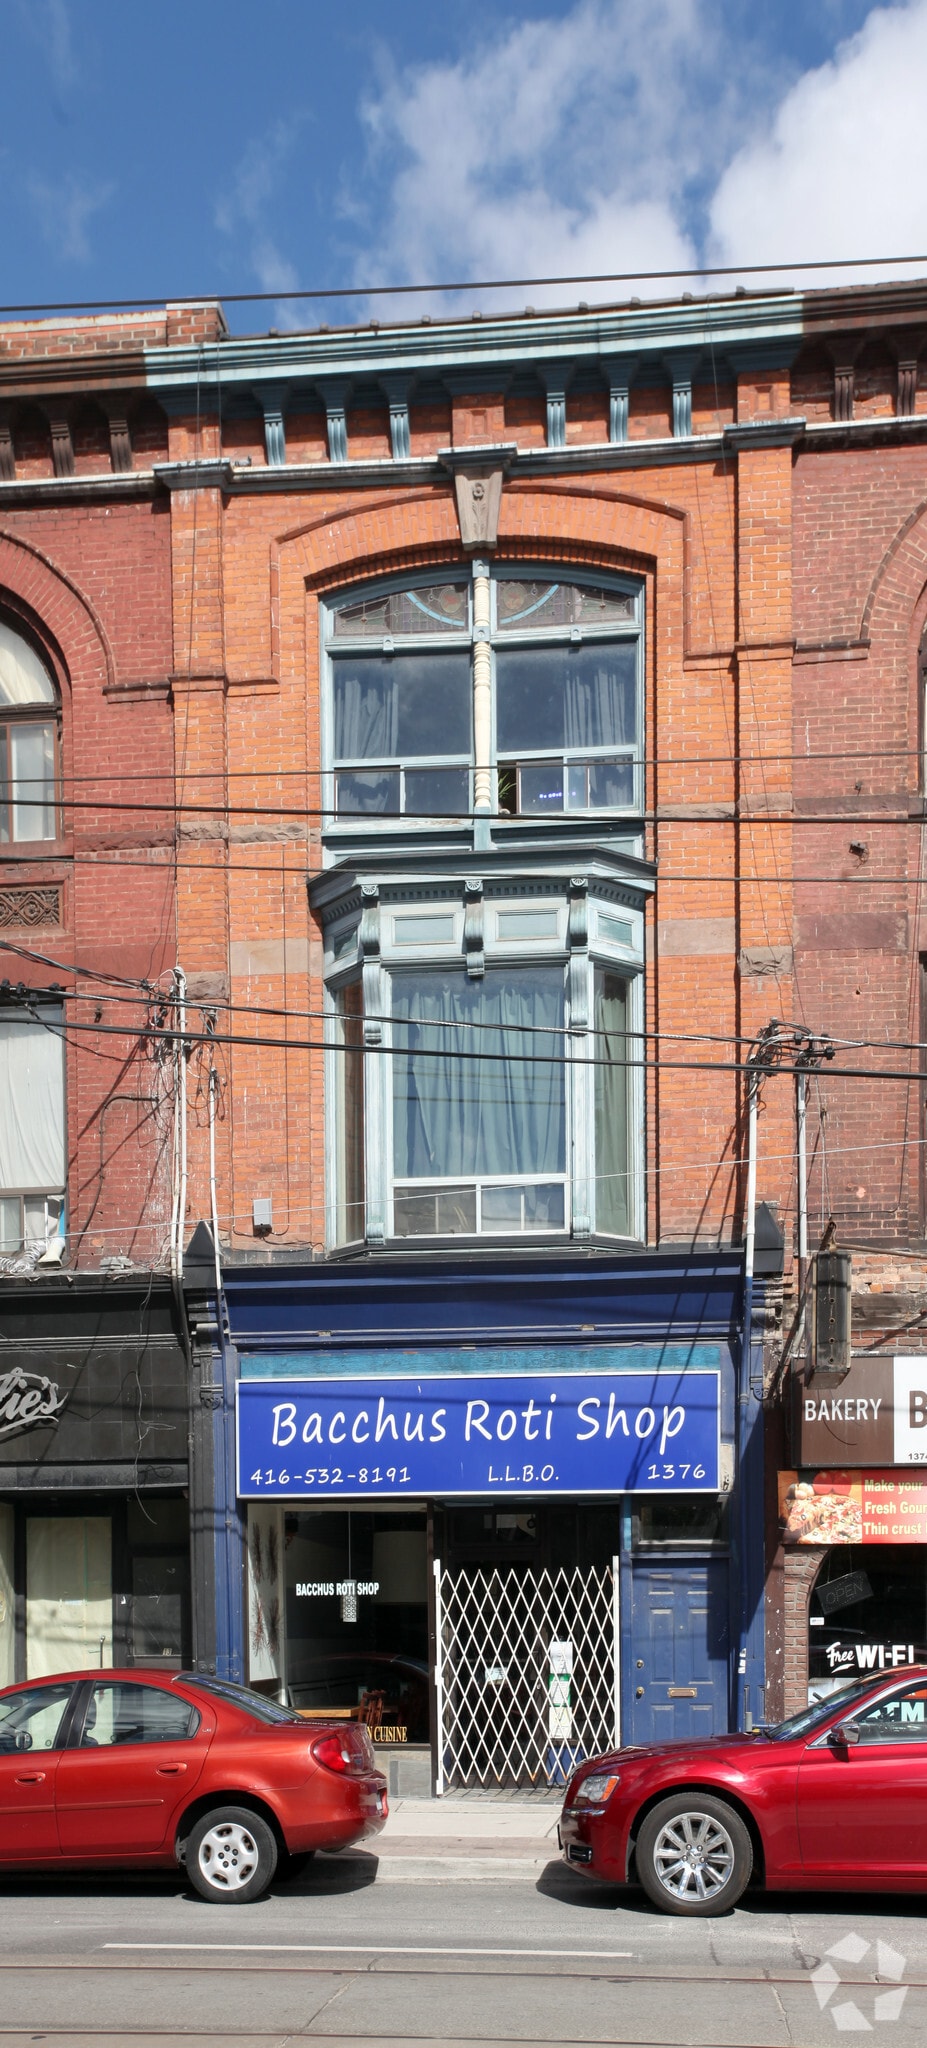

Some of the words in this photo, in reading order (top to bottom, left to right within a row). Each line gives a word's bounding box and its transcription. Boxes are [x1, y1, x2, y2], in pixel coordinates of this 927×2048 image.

[804, 1398, 882, 1421] BAKERY
[272, 1396, 447, 1447] Bacchus
[465, 1393, 557, 1442] Roti
[577, 1391, 686, 1456] Shop
[908, 1452, 927, 1461] 137
[250, 1466, 411, 1486] 416-532-8191
[488, 1464, 559, 1483] L.L.B.O.
[647, 1463, 706, 1481] 1376
[864, 1479, 895, 1492] Make
[898, 1481, 924, 1494] your
[864, 1501, 897, 1514] Fresh
[863, 1522, 888, 1535] Thin
[891, 1523, 922, 1535] crust
[295, 1583, 334, 1596] BACCHUS
[336, 1583, 356, 1596] ROTI
[357, 1582, 380, 1595] SHOP
[825, 1581, 864, 1605] OPEN
[826, 1641, 854, 1667] Free
[855, 1644, 914, 1668] WI-FI
[374, 1726, 407, 1742] CUISINE
